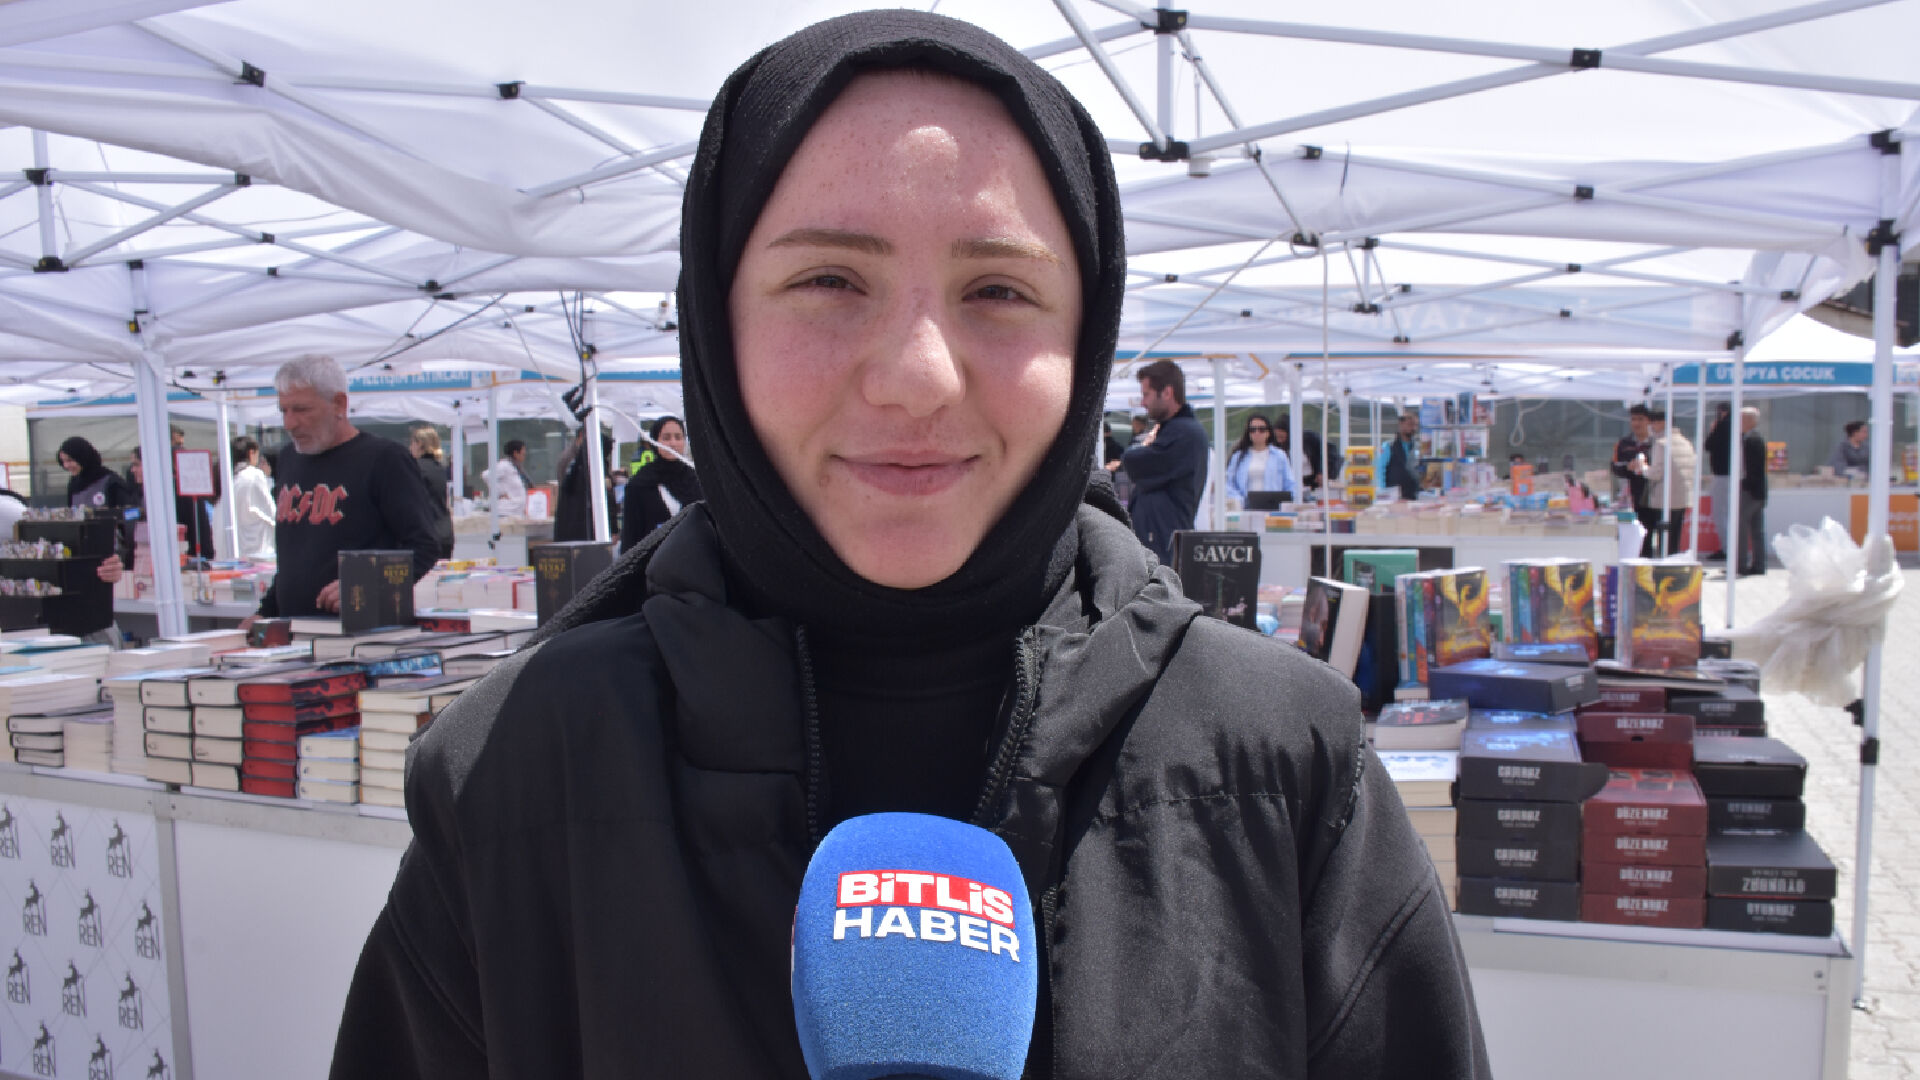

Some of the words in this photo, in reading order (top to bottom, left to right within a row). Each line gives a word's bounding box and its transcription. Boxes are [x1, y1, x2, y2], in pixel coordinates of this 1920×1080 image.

[1780, 366, 1836, 381] ÇOCUK
[1193, 544, 1253, 562] SAVCI
[50, 844, 76, 869] REN
[107, 855, 133, 878] REN
[23, 914, 47, 936] REN
[79, 924, 103, 948] REN
[833, 907, 1020, 962] HABER
[136, 936, 160, 960] REN
[7, 981, 30, 1005] REN
[62, 994, 87, 1017] REN
[118, 1006, 143, 1031] REN
[33, 1053, 56, 1078] REN
